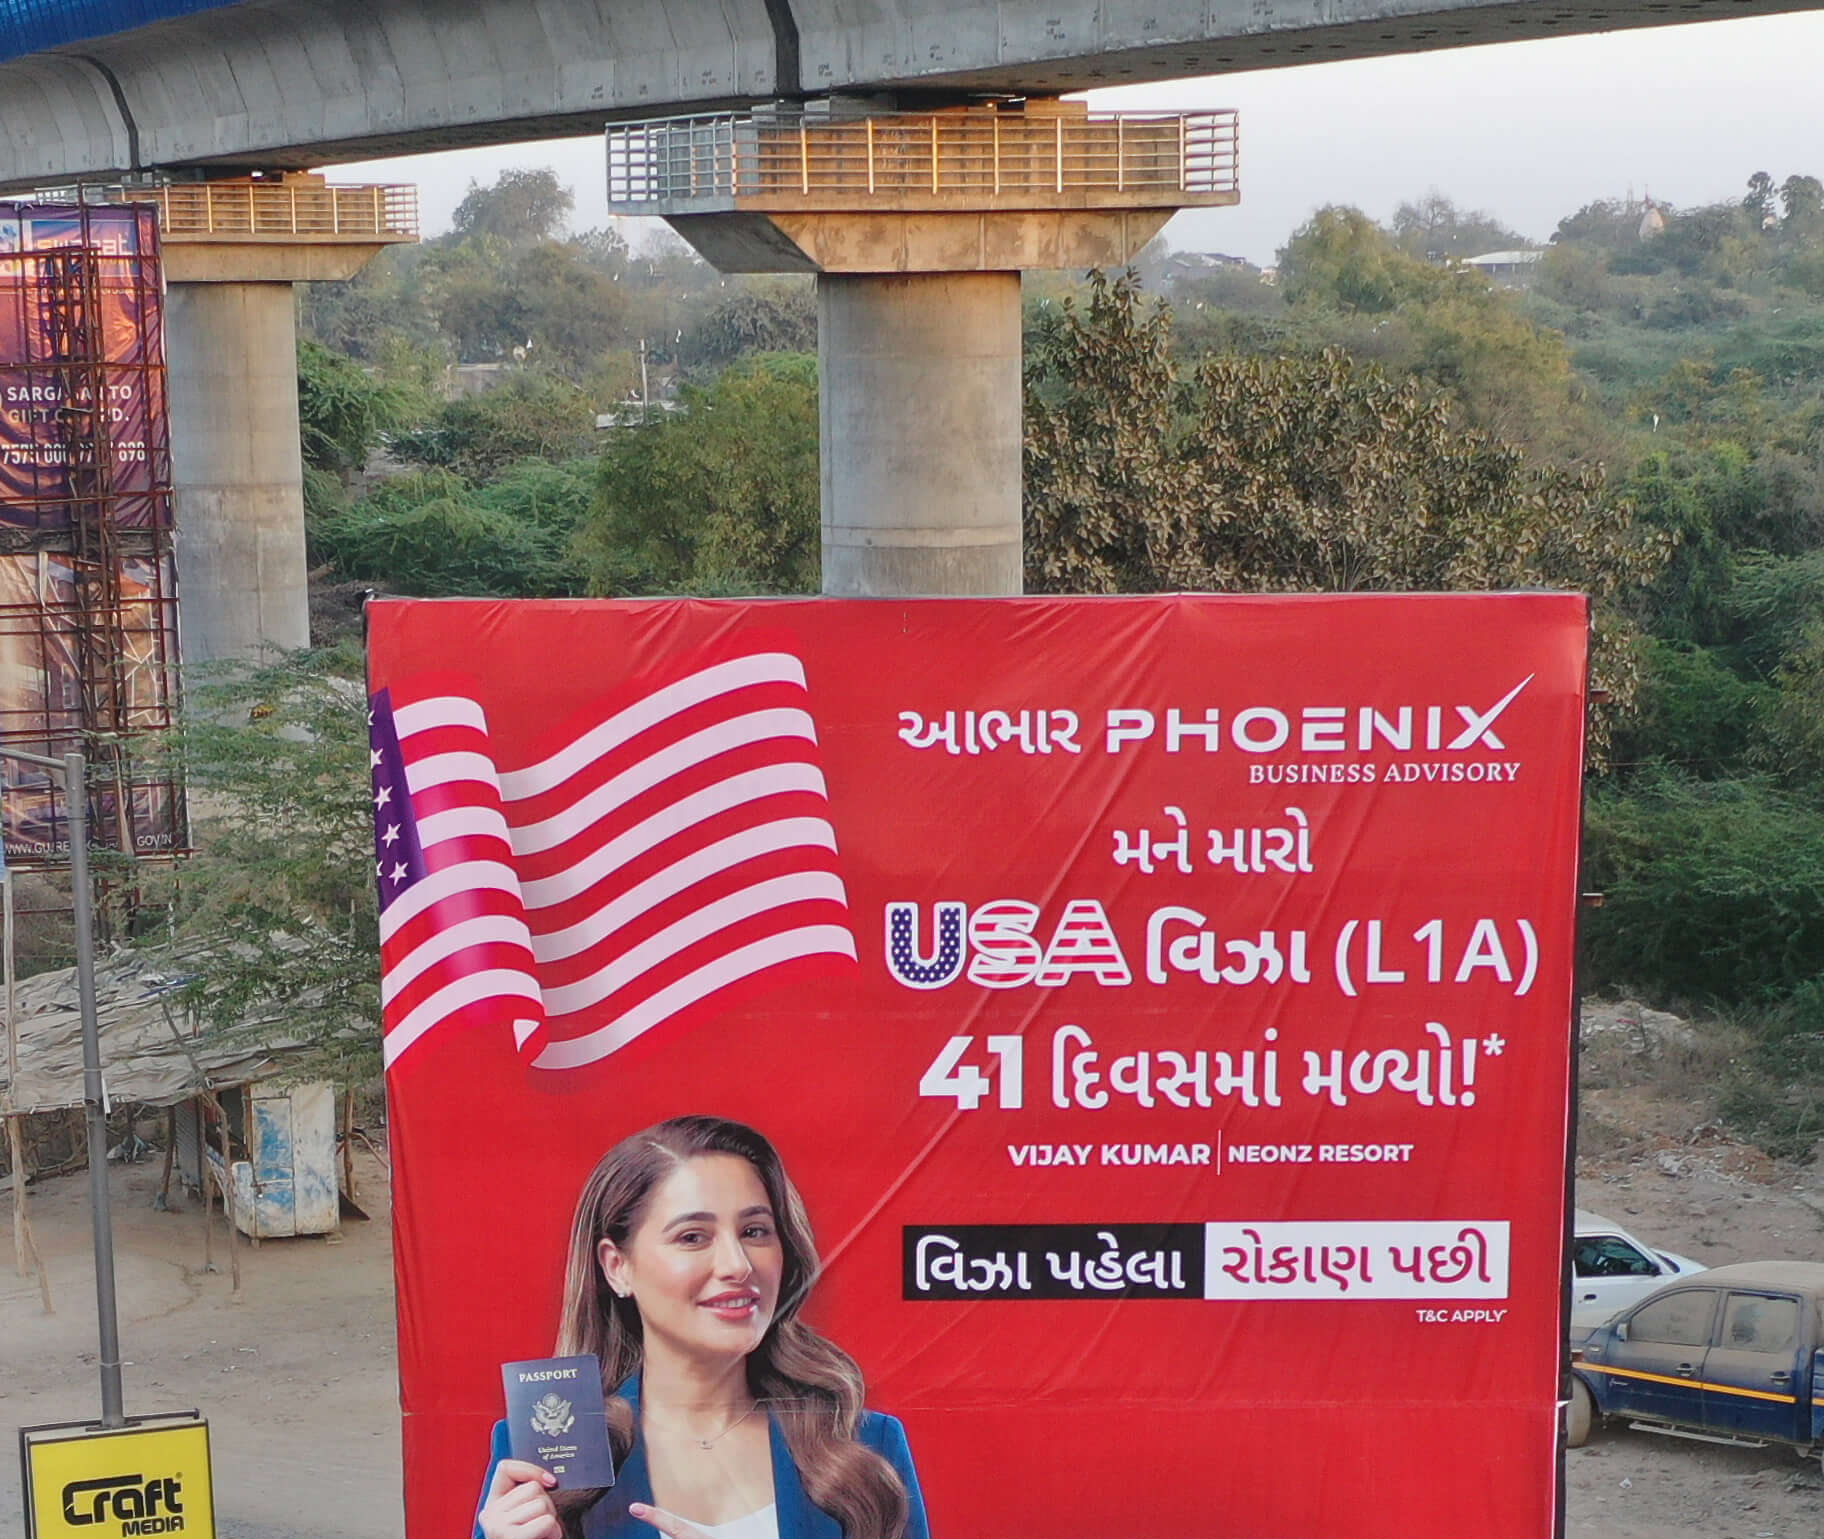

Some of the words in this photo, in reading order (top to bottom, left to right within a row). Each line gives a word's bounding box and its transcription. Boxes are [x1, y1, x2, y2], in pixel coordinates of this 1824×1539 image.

[110, 385, 132, 400] TO
[897, 708, 1082, 756] આભાર
[1106, 672, 1535, 754] PHOENIX
[1248, 763, 1377, 785] BUSINESS
[1383, 761, 1521, 784] ADVISORY
[1113, 806, 1193, 874] મને
[1207, 806, 1314, 874] મારો
[884, 899, 1133, 989] USA
[1146, 905, 1310, 984] વિઝા
[1334, 918, 1540, 997] (L1A)
[919, 1034, 1023, 1110] 41
[1051, 1024, 1281, 1108] દિવસમાં
[1008, 1145, 1093, 1167] VIJAY
[1101, 1143, 1211, 1165] KUMAR
[1228, 1144, 1313, 1164] NEONZ
[1318, 1143, 1414, 1163] RESORT
[915, 1234, 1028, 1291] વિઝા
[1047, 1232, 1186, 1290] પહેલા
[1222, 1229, 1370, 1291] રોકાણ
[1388, 1229, 1492, 1286] પછી
[1416, 1309, 1448, 1323] T&C
[519, 1368, 578, 1383] PASSPORT
[62, 1474, 183, 1526] Craft
[121, 1515, 184, 1538] MEDIA
